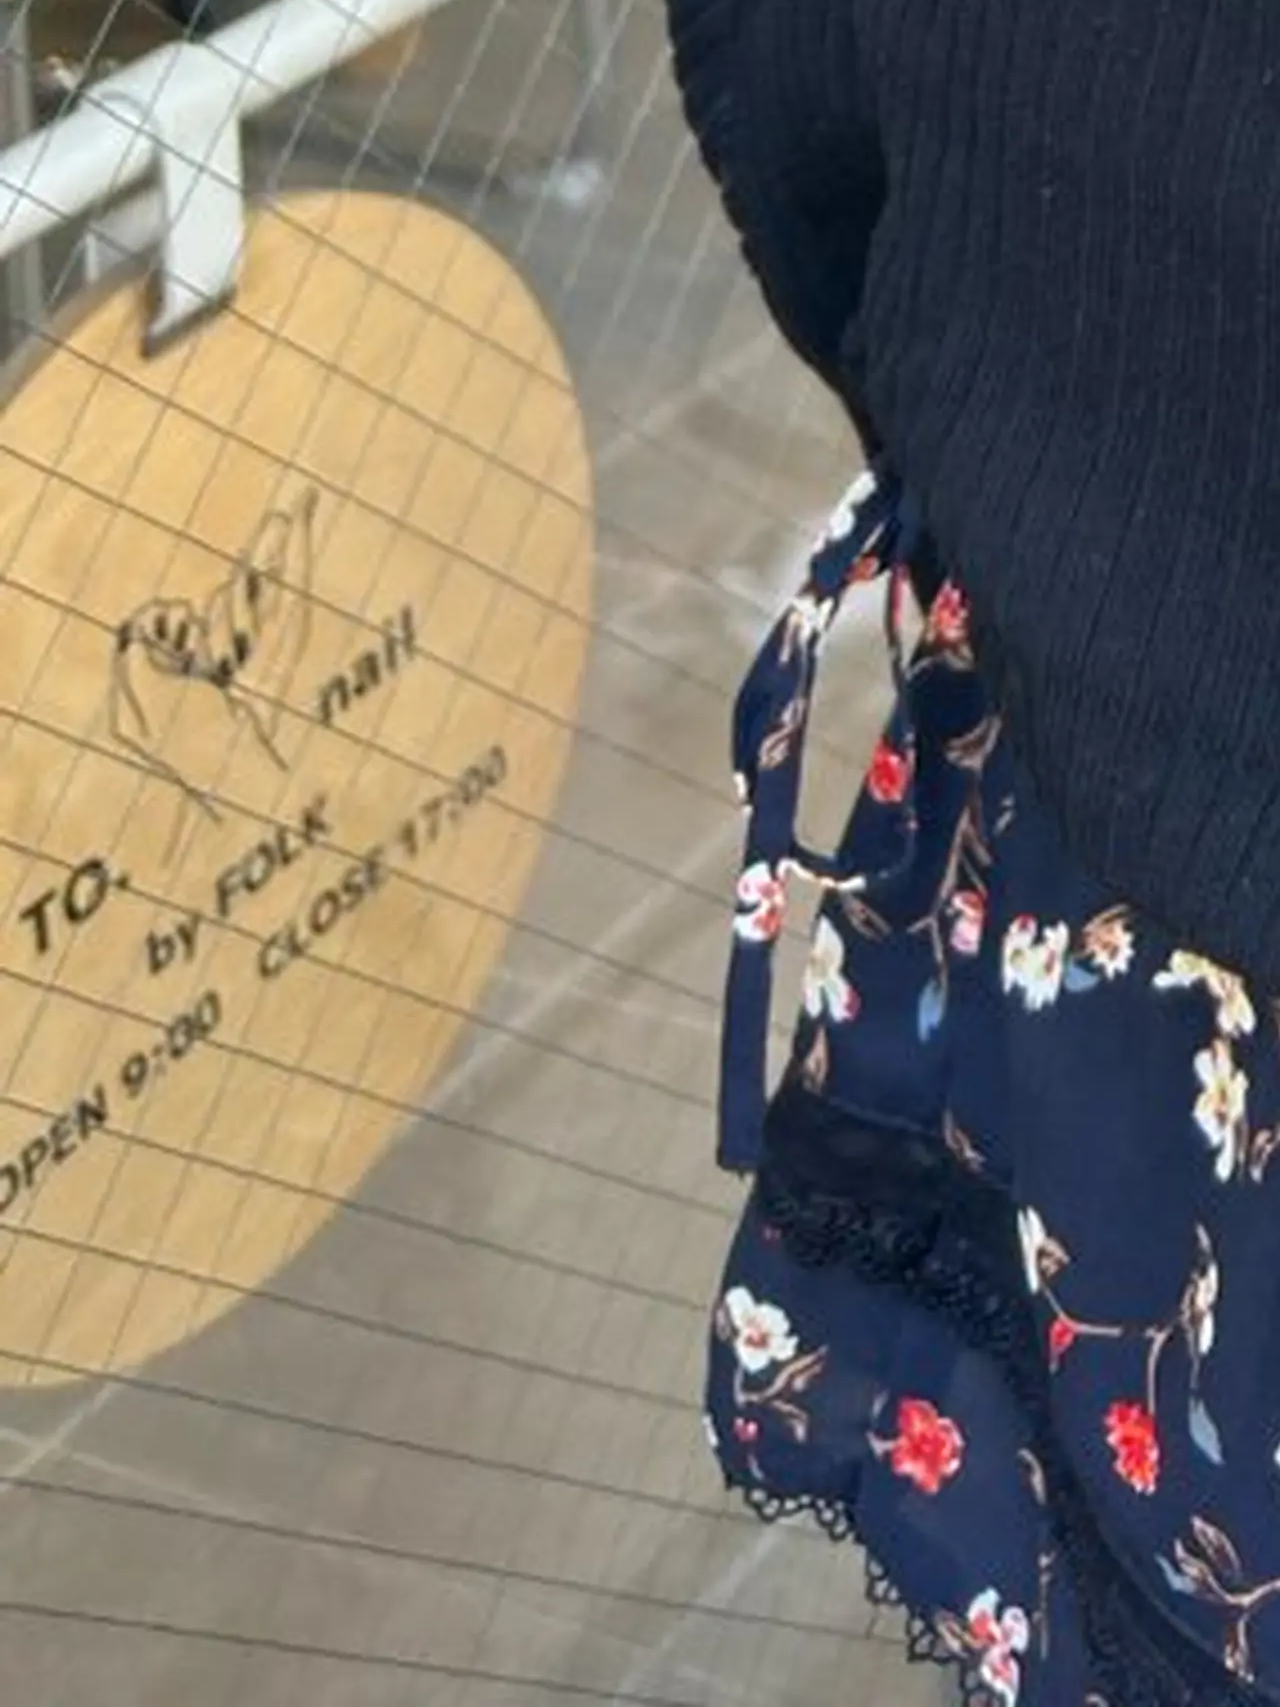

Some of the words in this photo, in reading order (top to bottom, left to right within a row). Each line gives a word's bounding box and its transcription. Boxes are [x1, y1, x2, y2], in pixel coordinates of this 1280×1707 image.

[317, 603, 416, 727] nail
[119, 988, 222, 1102] 9:00
[258, 844, 387, 978] CLOSE
[145, 912, 202, 976] by
[215, 792, 330, 918] FOLK
